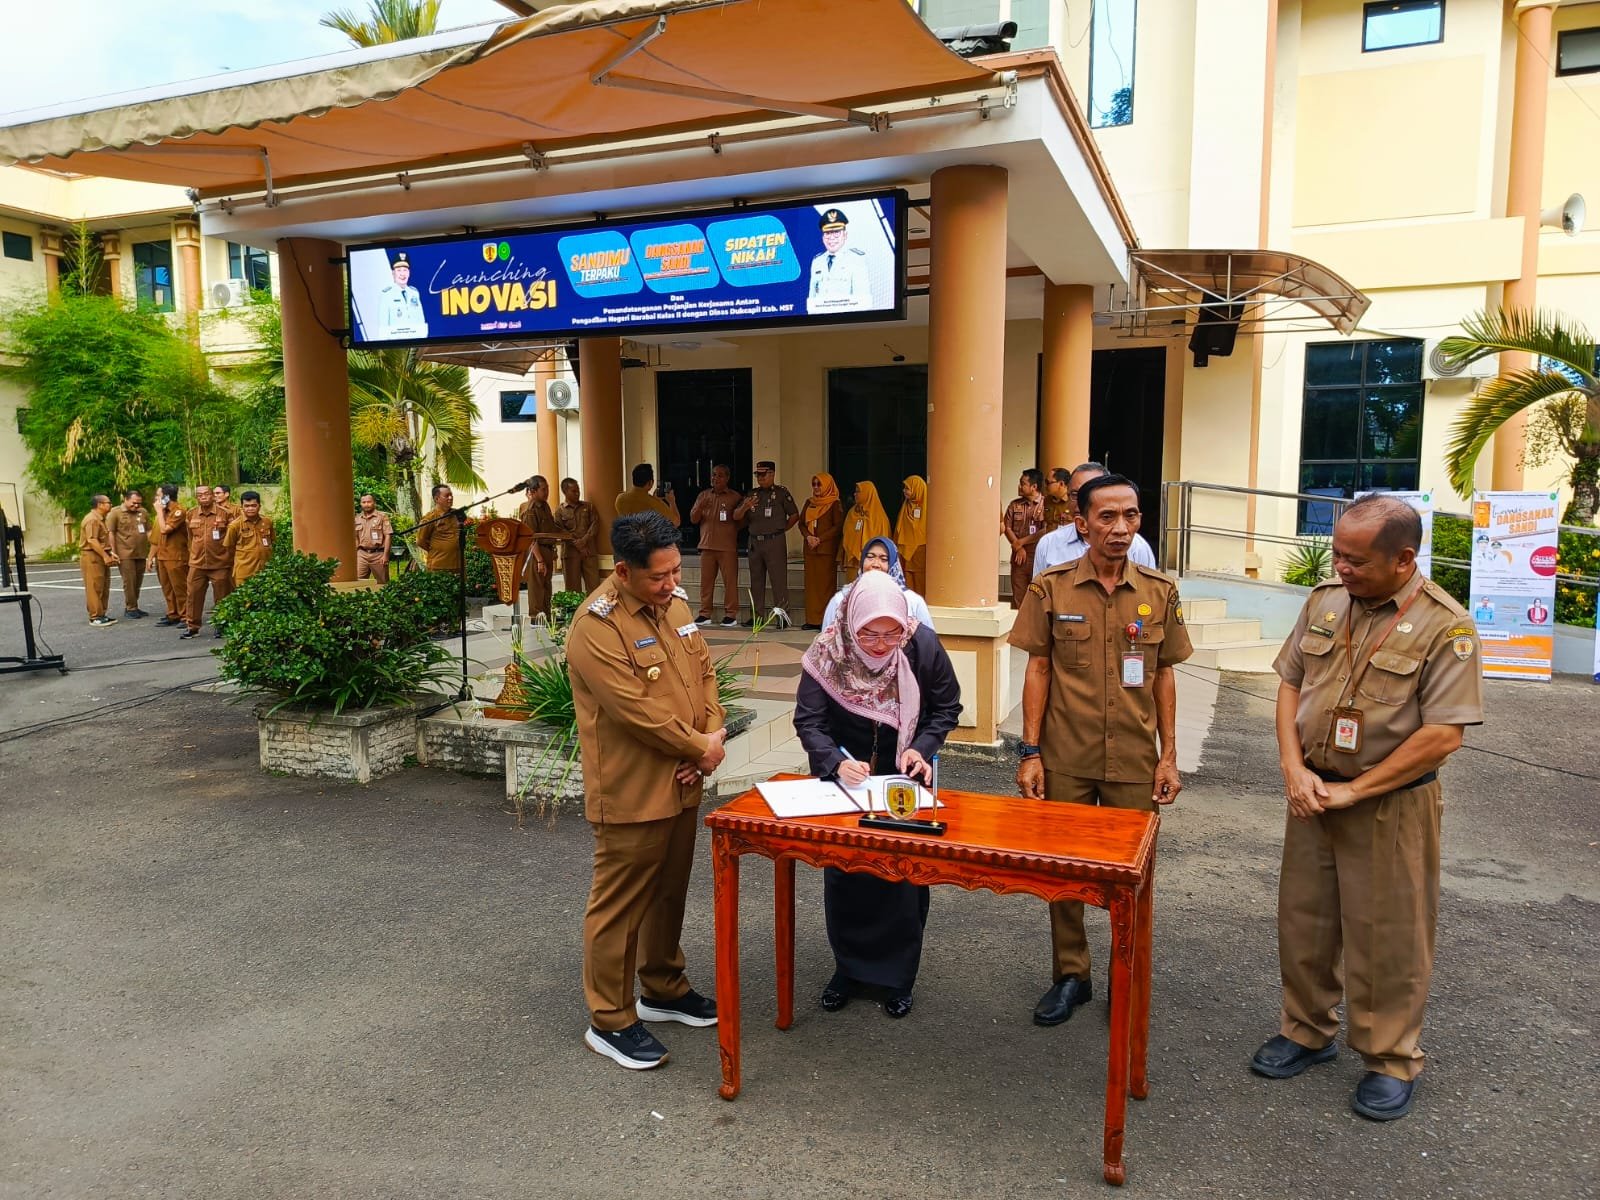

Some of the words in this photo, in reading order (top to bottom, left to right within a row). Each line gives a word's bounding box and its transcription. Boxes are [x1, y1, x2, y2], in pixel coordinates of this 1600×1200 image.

[725, 232, 787, 251] SIPATEN
[570, 247, 631, 272] SANDIMU
[730, 247, 777, 265] NIKAH
[429, 256, 551, 307] Launching
[580, 266, 621, 282] TERPAKU
[441, 279, 557, 316] INOVASI
[663, 301, 697, 312] Perjanjian
[698, 300, 734, 309] Kerjasama
[735, 298, 760, 306] Antara
[608, 314, 630, 323] Negeri
[682, 310, 708, 319] dengan
[1508, 520, 1537, 534] SANDI
